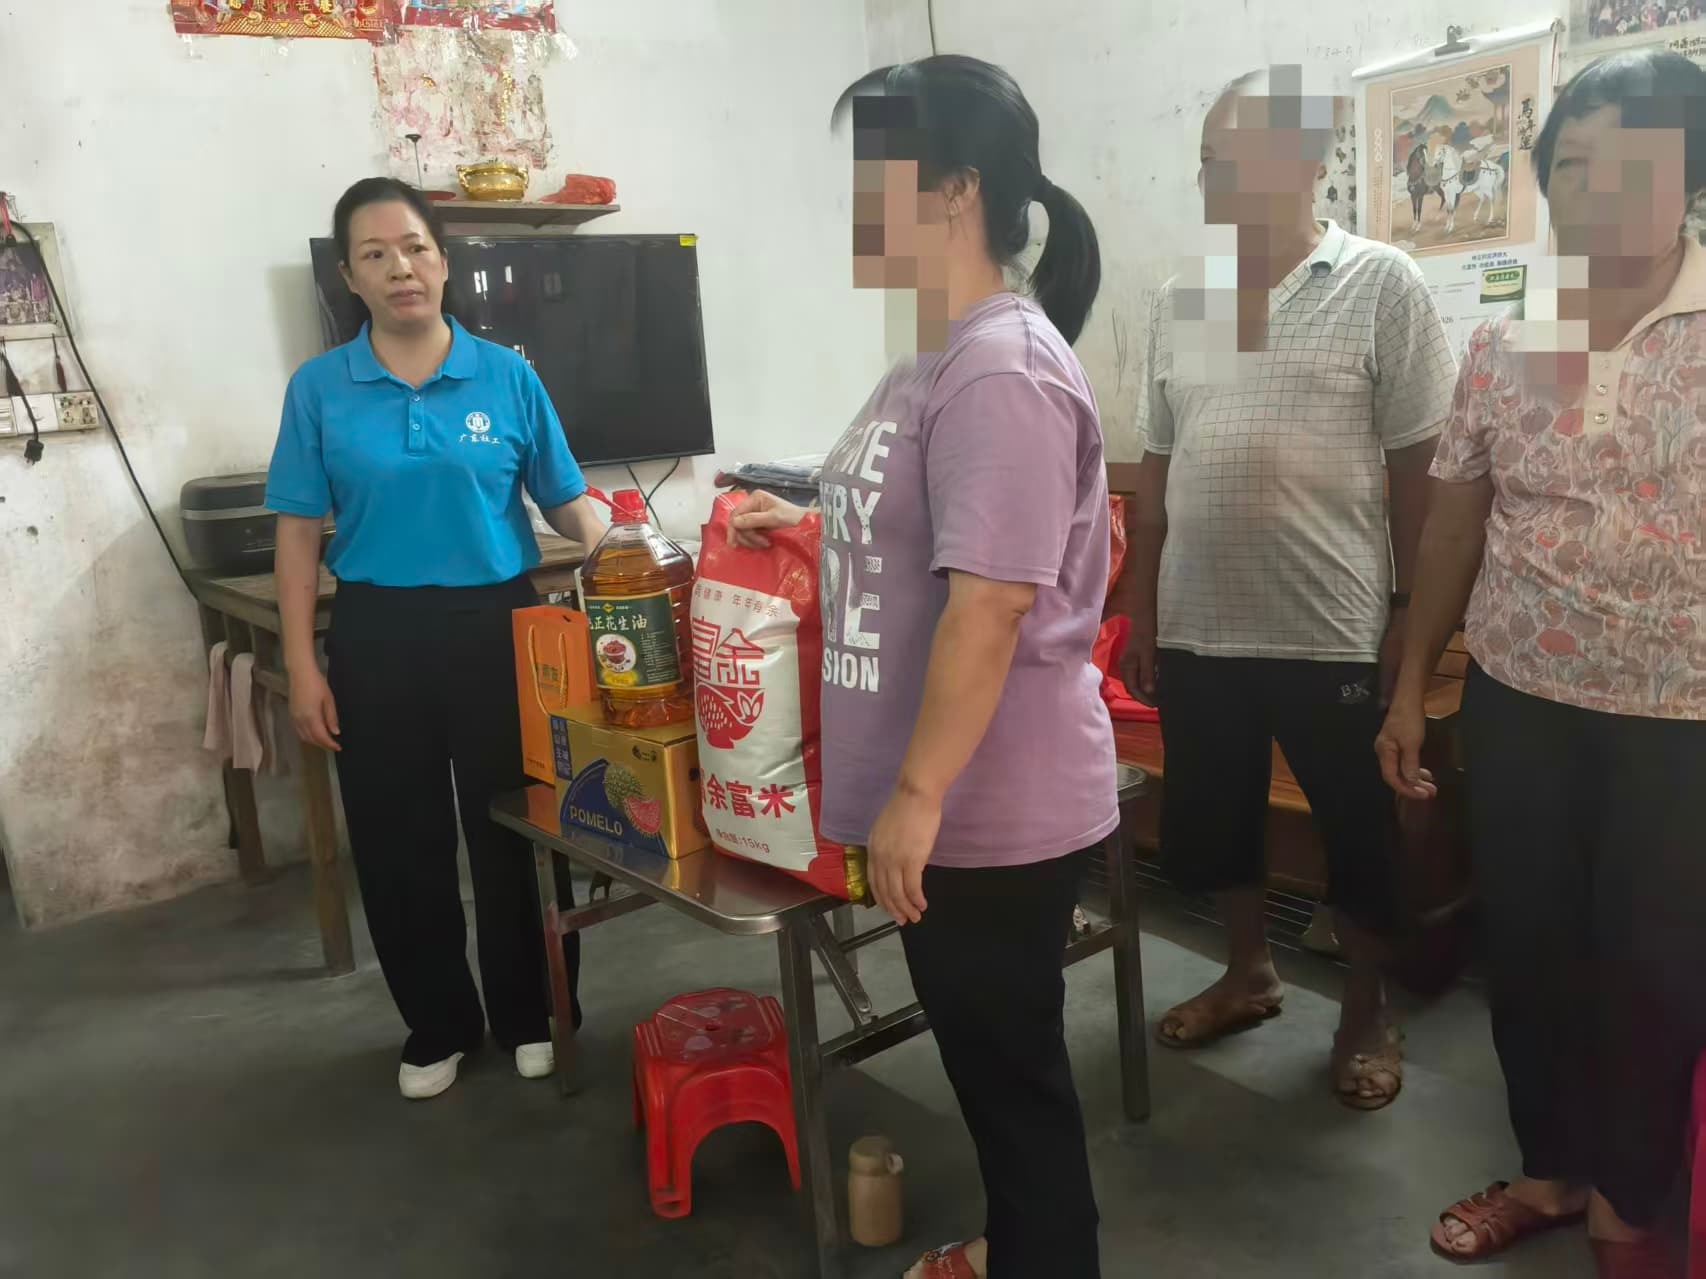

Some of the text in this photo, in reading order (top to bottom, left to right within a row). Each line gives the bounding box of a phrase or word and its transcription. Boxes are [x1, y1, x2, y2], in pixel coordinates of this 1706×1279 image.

[701, 768, 796, 818] 余富米
[569, 804, 623, 836] POMELO
